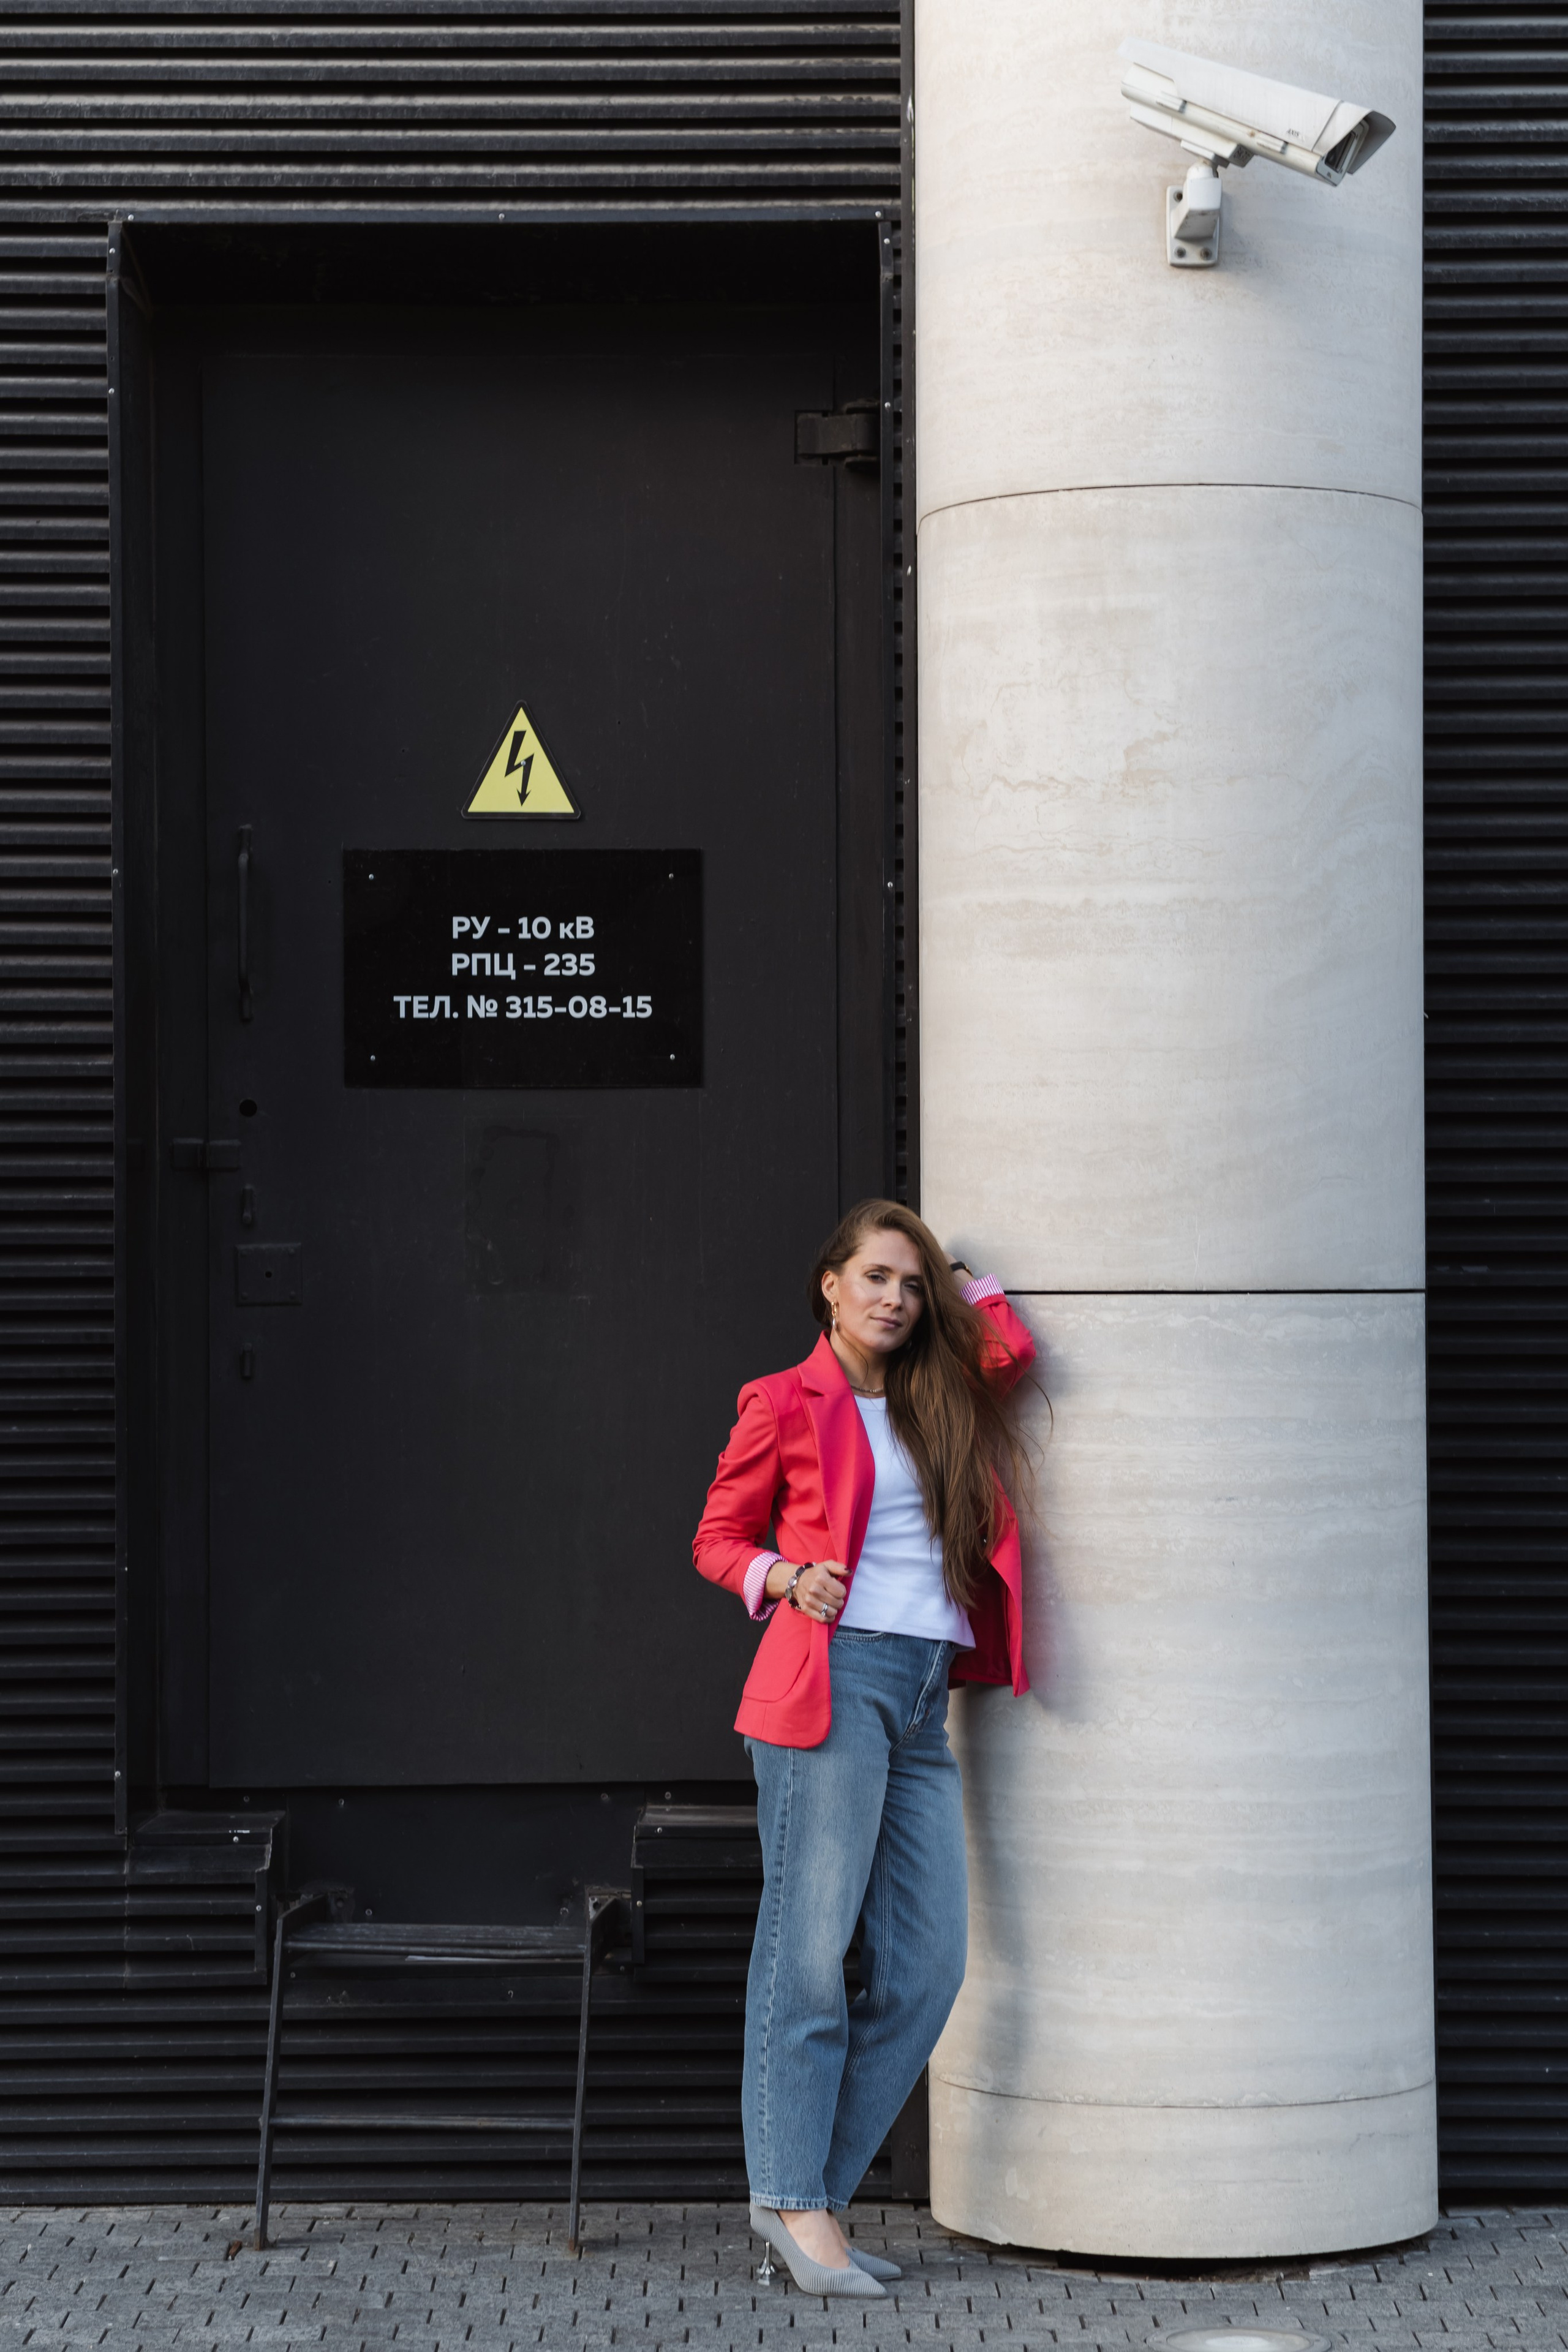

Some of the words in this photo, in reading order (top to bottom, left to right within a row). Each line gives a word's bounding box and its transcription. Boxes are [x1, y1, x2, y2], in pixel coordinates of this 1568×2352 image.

[453, 916, 491, 939] РУ
[518, 916, 551, 939] 10
[559, 916, 594, 939] кВ
[452, 953, 516, 980] РПЦ
[544, 953, 595, 976] 235
[393, 995, 459, 1019] ТЕЛ.
[467, 995, 498, 1018] №
[505, 995, 652, 1019] 315-08-15
